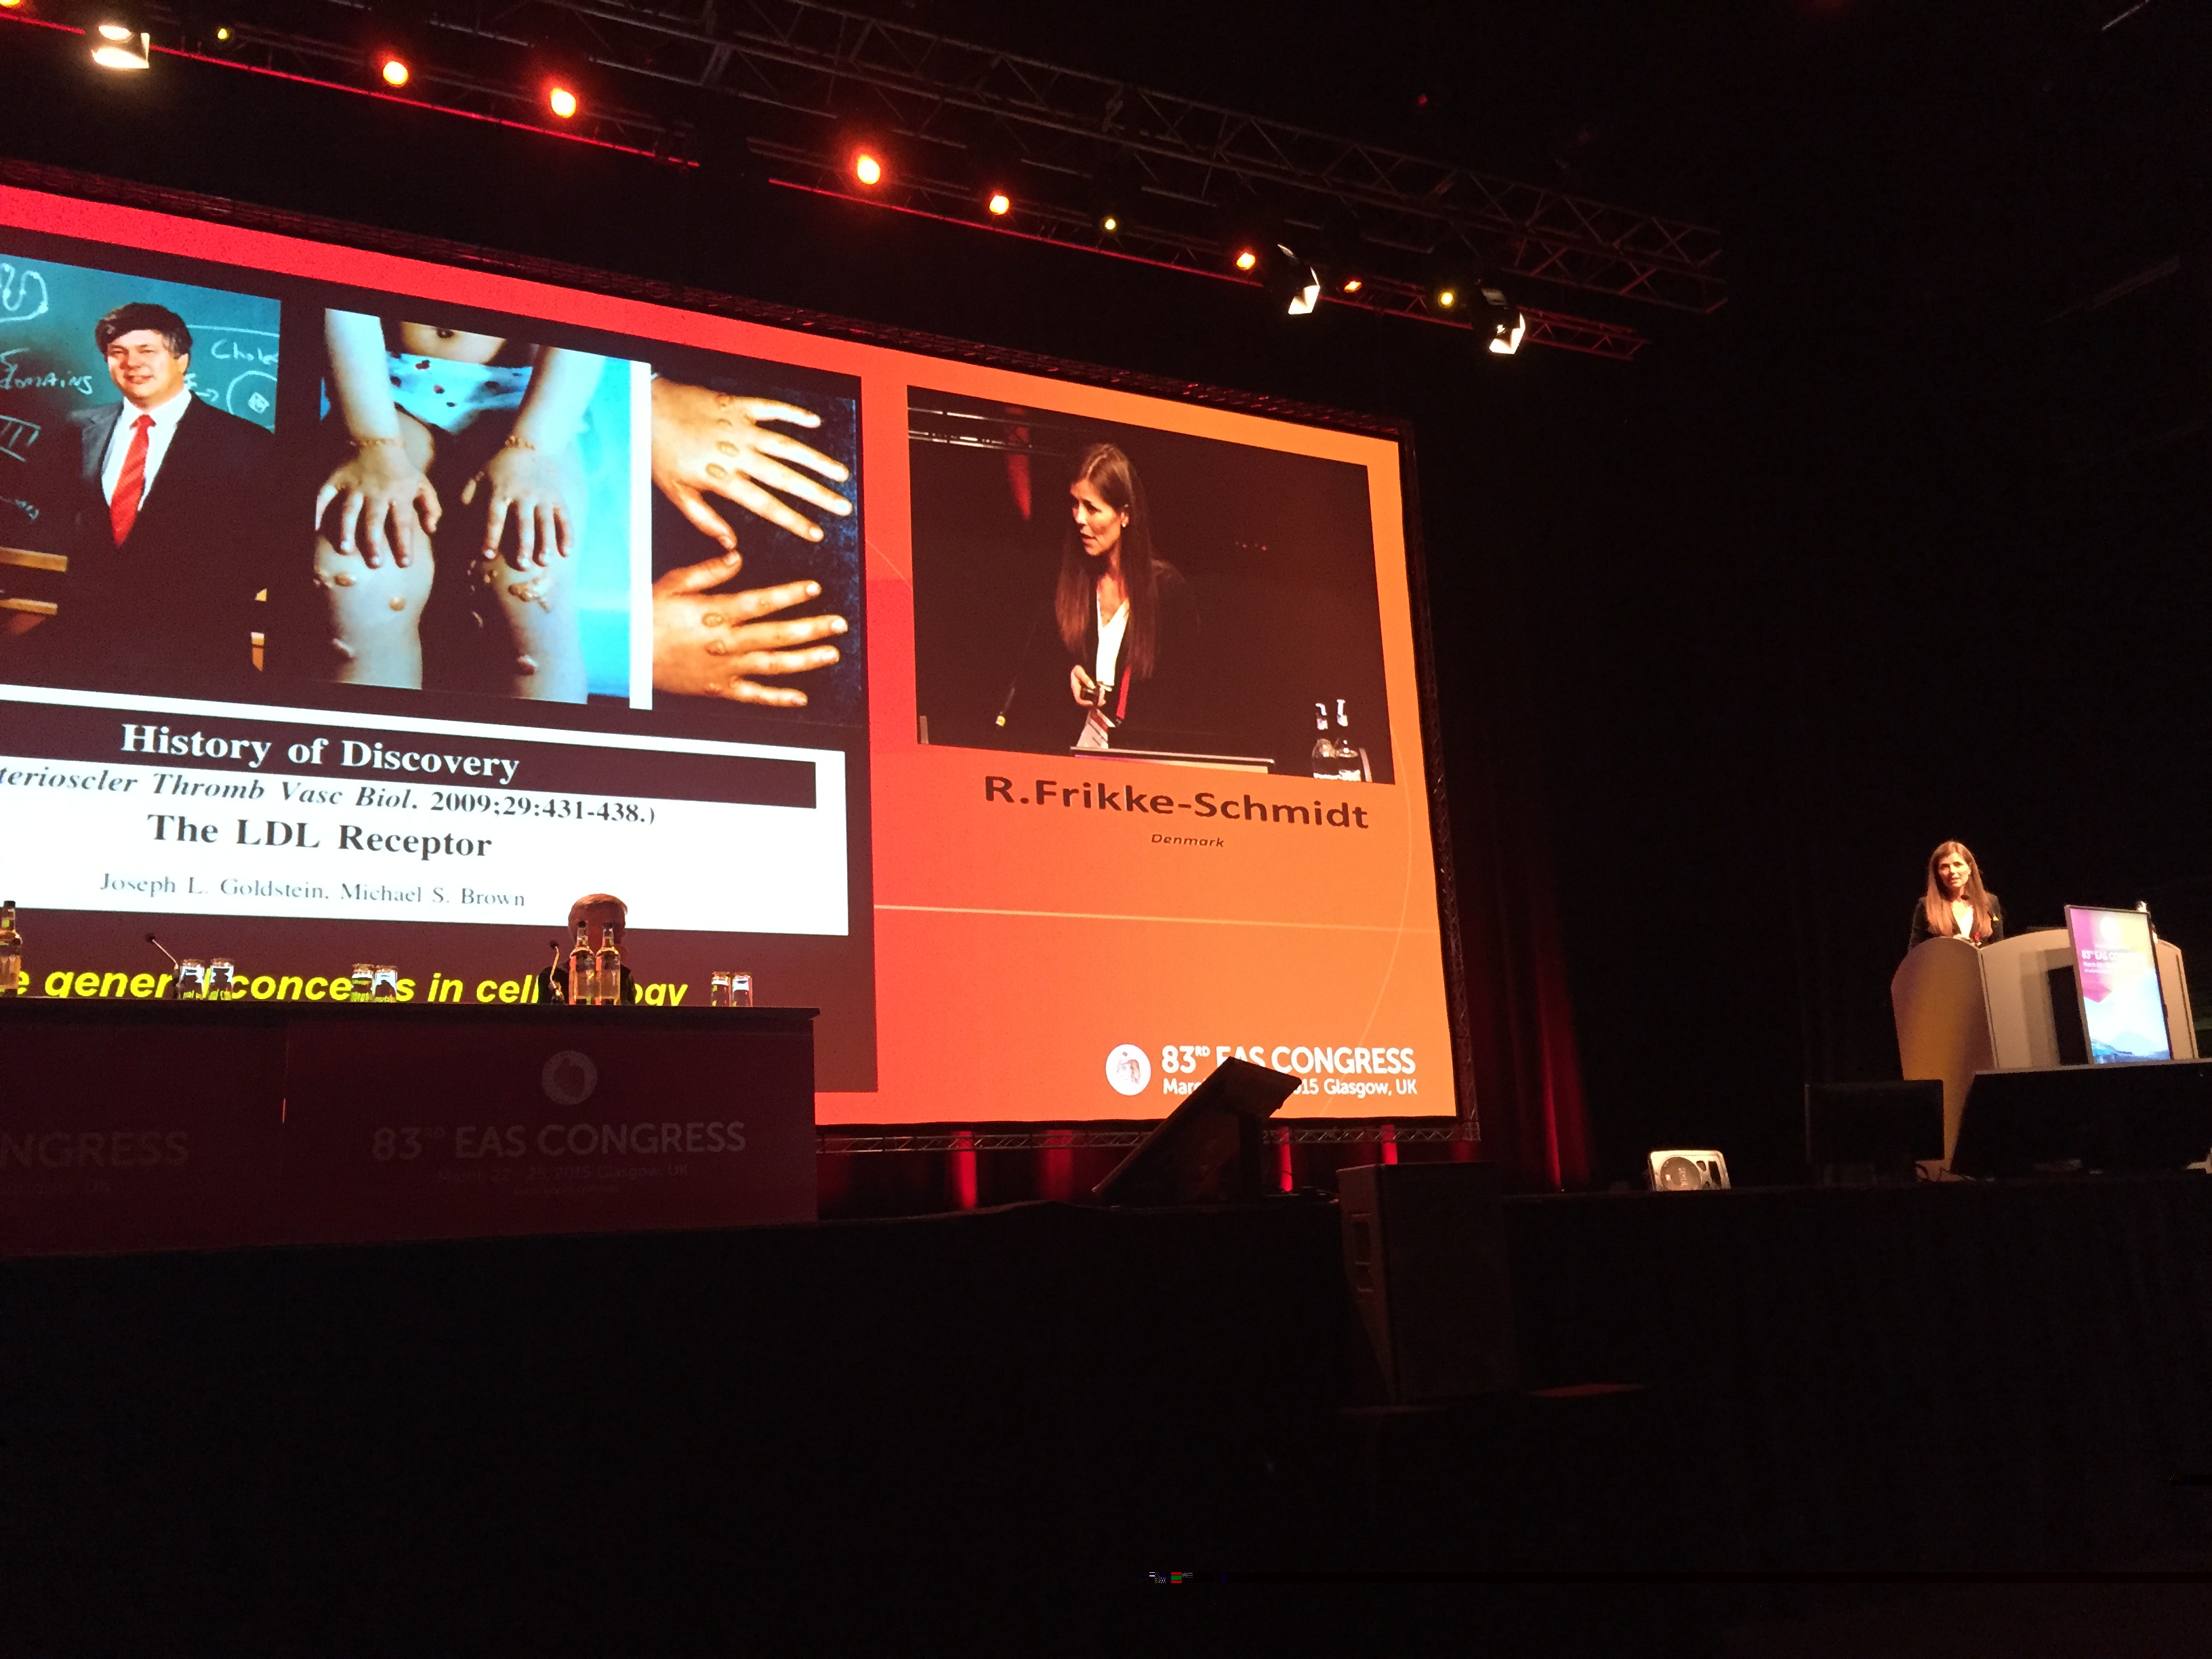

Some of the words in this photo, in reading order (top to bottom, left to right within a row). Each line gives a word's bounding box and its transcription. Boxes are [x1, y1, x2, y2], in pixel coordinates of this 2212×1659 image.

[121, 723, 272, 770] History
[288, 738, 329, 764] of
[341, 740, 520, 785] Discovery
[153, 773, 265, 800] Thromb
[282, 781, 343, 804] Vasc
[355, 786, 417, 810] Biol.
[430, 791, 655, 825] 2009;29:431-438.)
[985, 775, 1369, 829] R.Frikke-Schmidt
[148, 815, 218, 842] The
[237, 819, 319, 847] LDL
[339, 825, 491, 861] Receptor
[1151, 834, 1223, 846] Denmark
[100, 873, 176, 898] Joseph
[188, 877, 208, 895] L.
[340, 883, 422, 903] Michael
[432, 886, 450, 903] S.
[461, 888, 525, 907] Brown
[45, 968, 211, 999] generl
[232, 975, 416, 1002] conces
[428, 973, 463, 1002] in
[476, 975, 539, 1004] cell
[1271, 1046, 1416, 1074] CONGRESS
[1324, 1078, 1391, 1099] Glasgow,
[1396, 1079, 1417, 1094] UK
[455, 1125, 527, 1158] EAS
[537, 1122, 745, 1155] CONGRESS
[668, 1163, 689, 1176] UK
